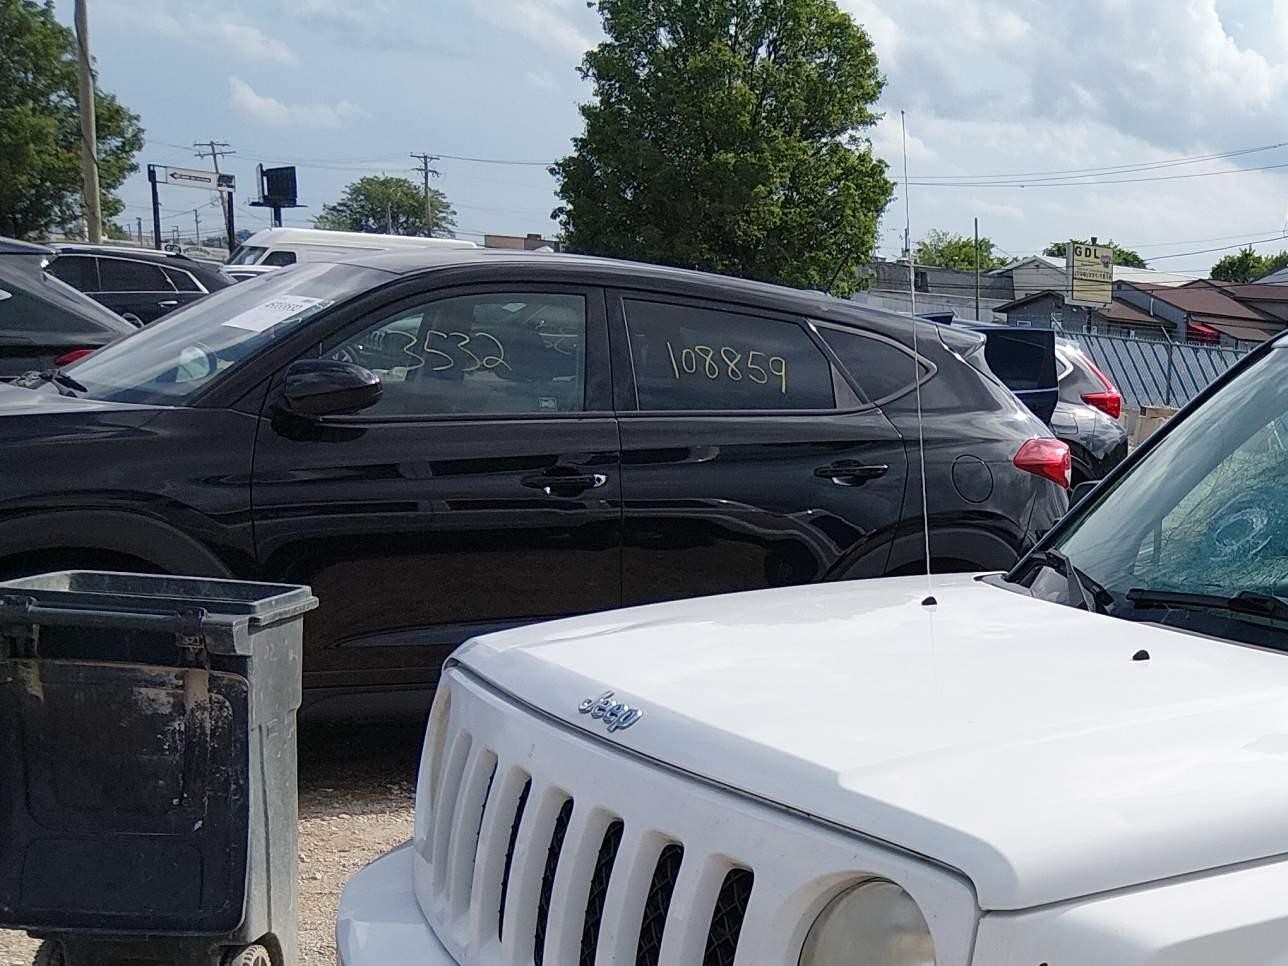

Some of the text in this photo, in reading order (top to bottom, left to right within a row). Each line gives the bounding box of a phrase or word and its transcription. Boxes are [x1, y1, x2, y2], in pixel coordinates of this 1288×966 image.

[1074, 246, 1100, 259] GDL
[386, 330, 512, 371] 3532
[666, 341, 787, 394] 108859
[578, 690, 643, 733] Jeep
